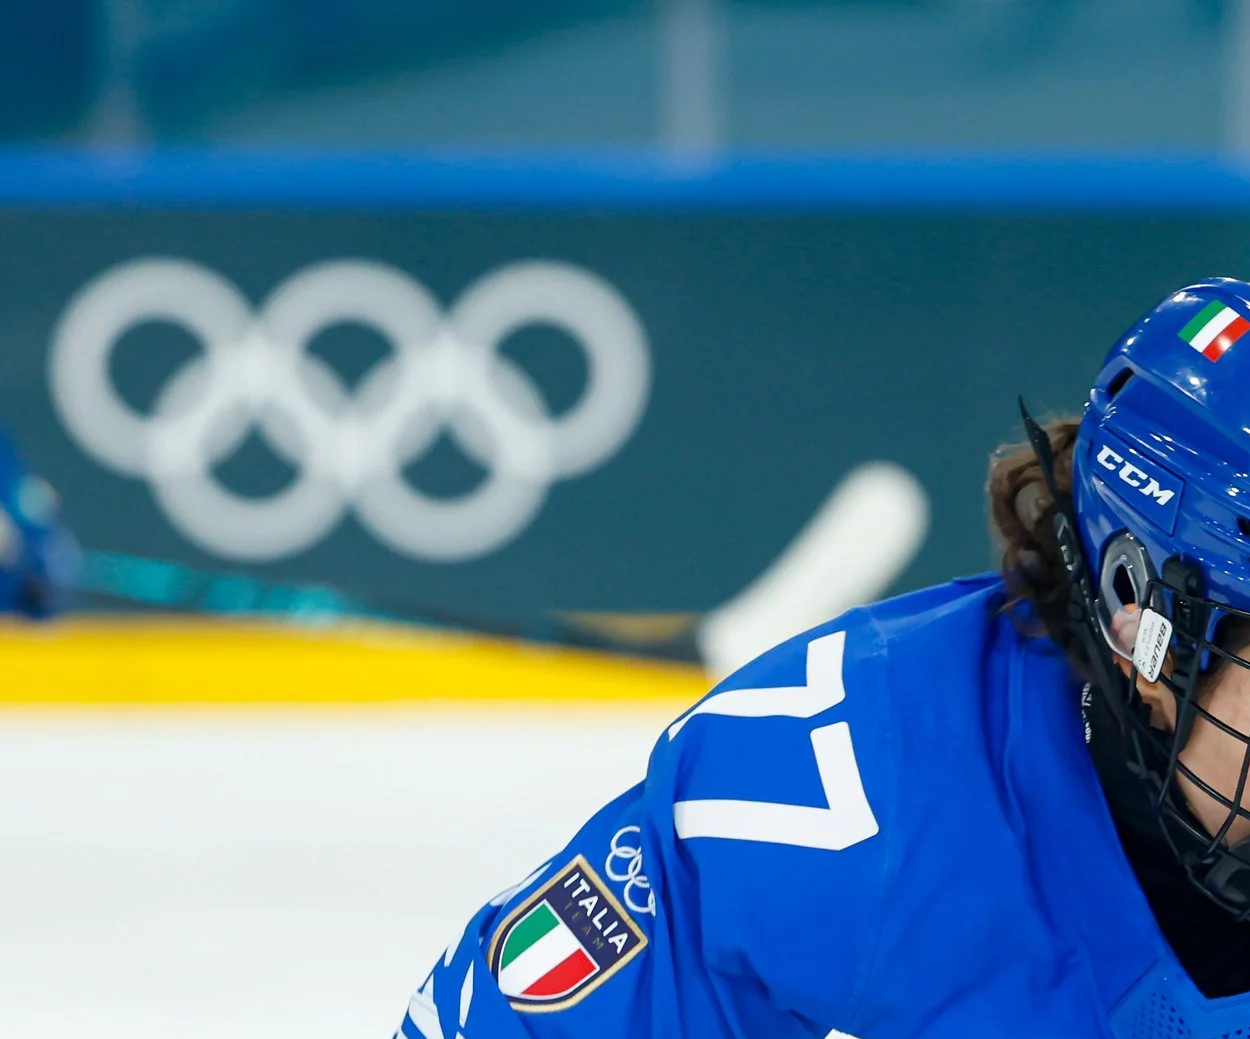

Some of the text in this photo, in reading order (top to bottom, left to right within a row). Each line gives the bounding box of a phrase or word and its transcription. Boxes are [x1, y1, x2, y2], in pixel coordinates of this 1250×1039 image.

[1097, 445, 1174, 506] CCM
[668, 630, 879, 850] 77
[563, 872, 628, 954] ITALIA
